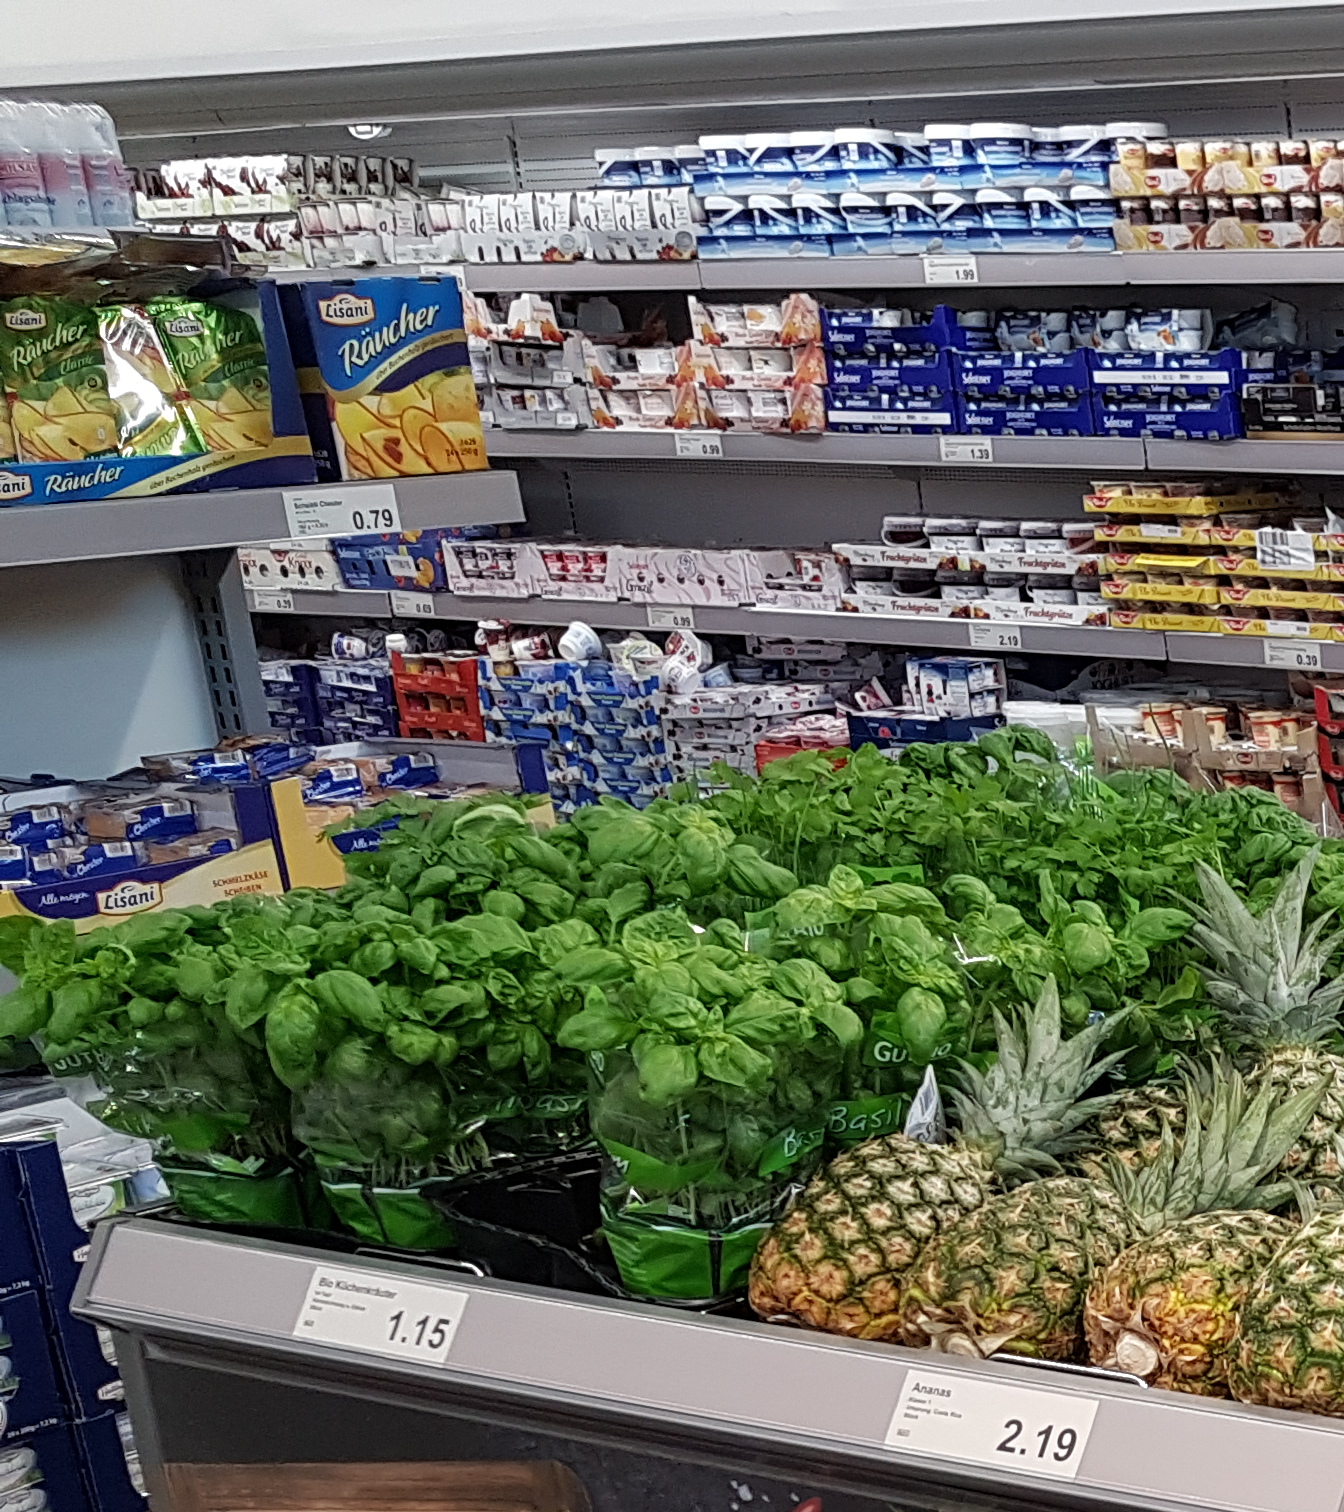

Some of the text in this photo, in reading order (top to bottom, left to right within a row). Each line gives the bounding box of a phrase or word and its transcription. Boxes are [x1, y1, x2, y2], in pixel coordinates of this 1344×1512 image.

[9, 312, 43, 327] Lisani
[325, 303, 369, 320] Lisani
[10, 322, 88, 372] Räucher
[338, 301, 441, 378] Räucher
[44, 463, 126, 497] Räucher
[352, 508, 394, 531] 0.79
[104, 887, 156, 911] Lisani
[389, 1310, 451, 1350] 1.15
[912, 1382, 952, 1398] Ananas
[996, 1418, 1078, 1462] 2.19
